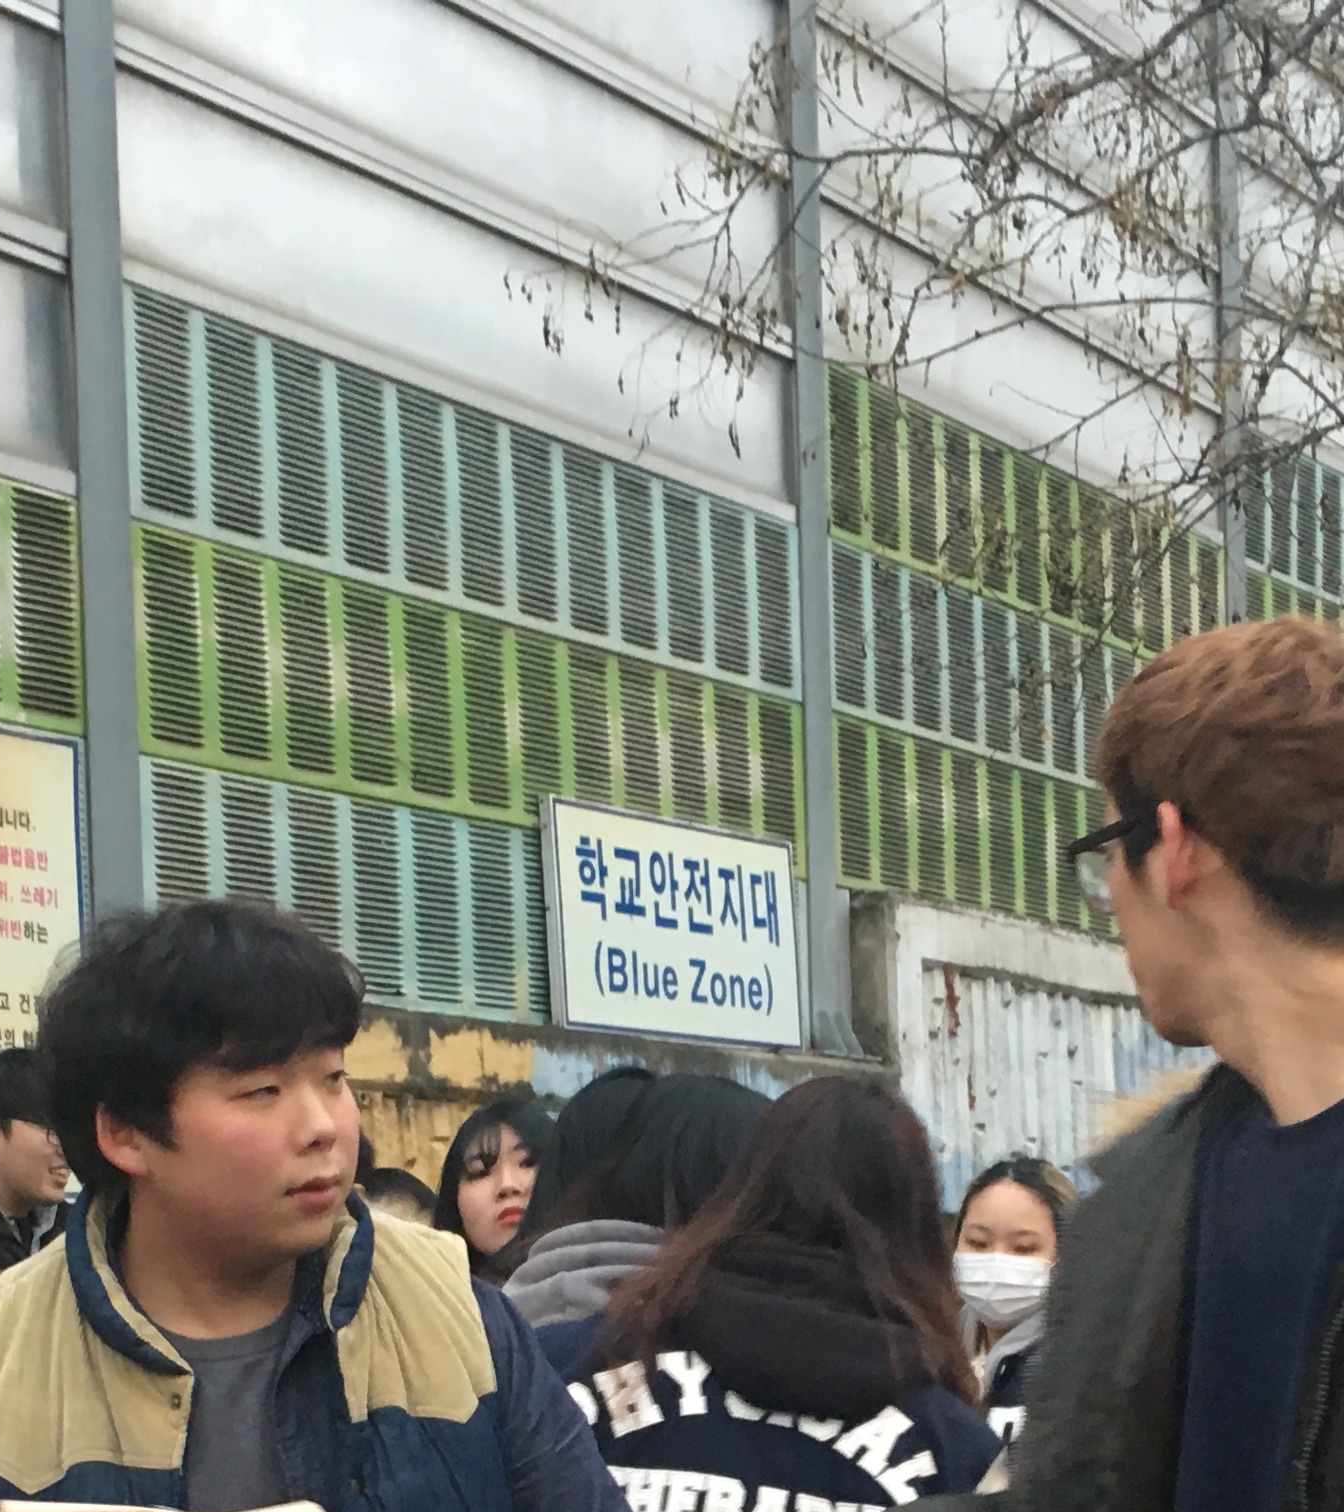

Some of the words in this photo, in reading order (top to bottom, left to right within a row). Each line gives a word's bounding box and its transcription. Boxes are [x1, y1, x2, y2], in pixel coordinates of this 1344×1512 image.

[20, 884, 58, 909] 쓰레기
[575, 835, 780, 947] 학교안전지대
[594, 940, 679, 1001] (Blue
[689, 958, 774, 1016] Zone)
